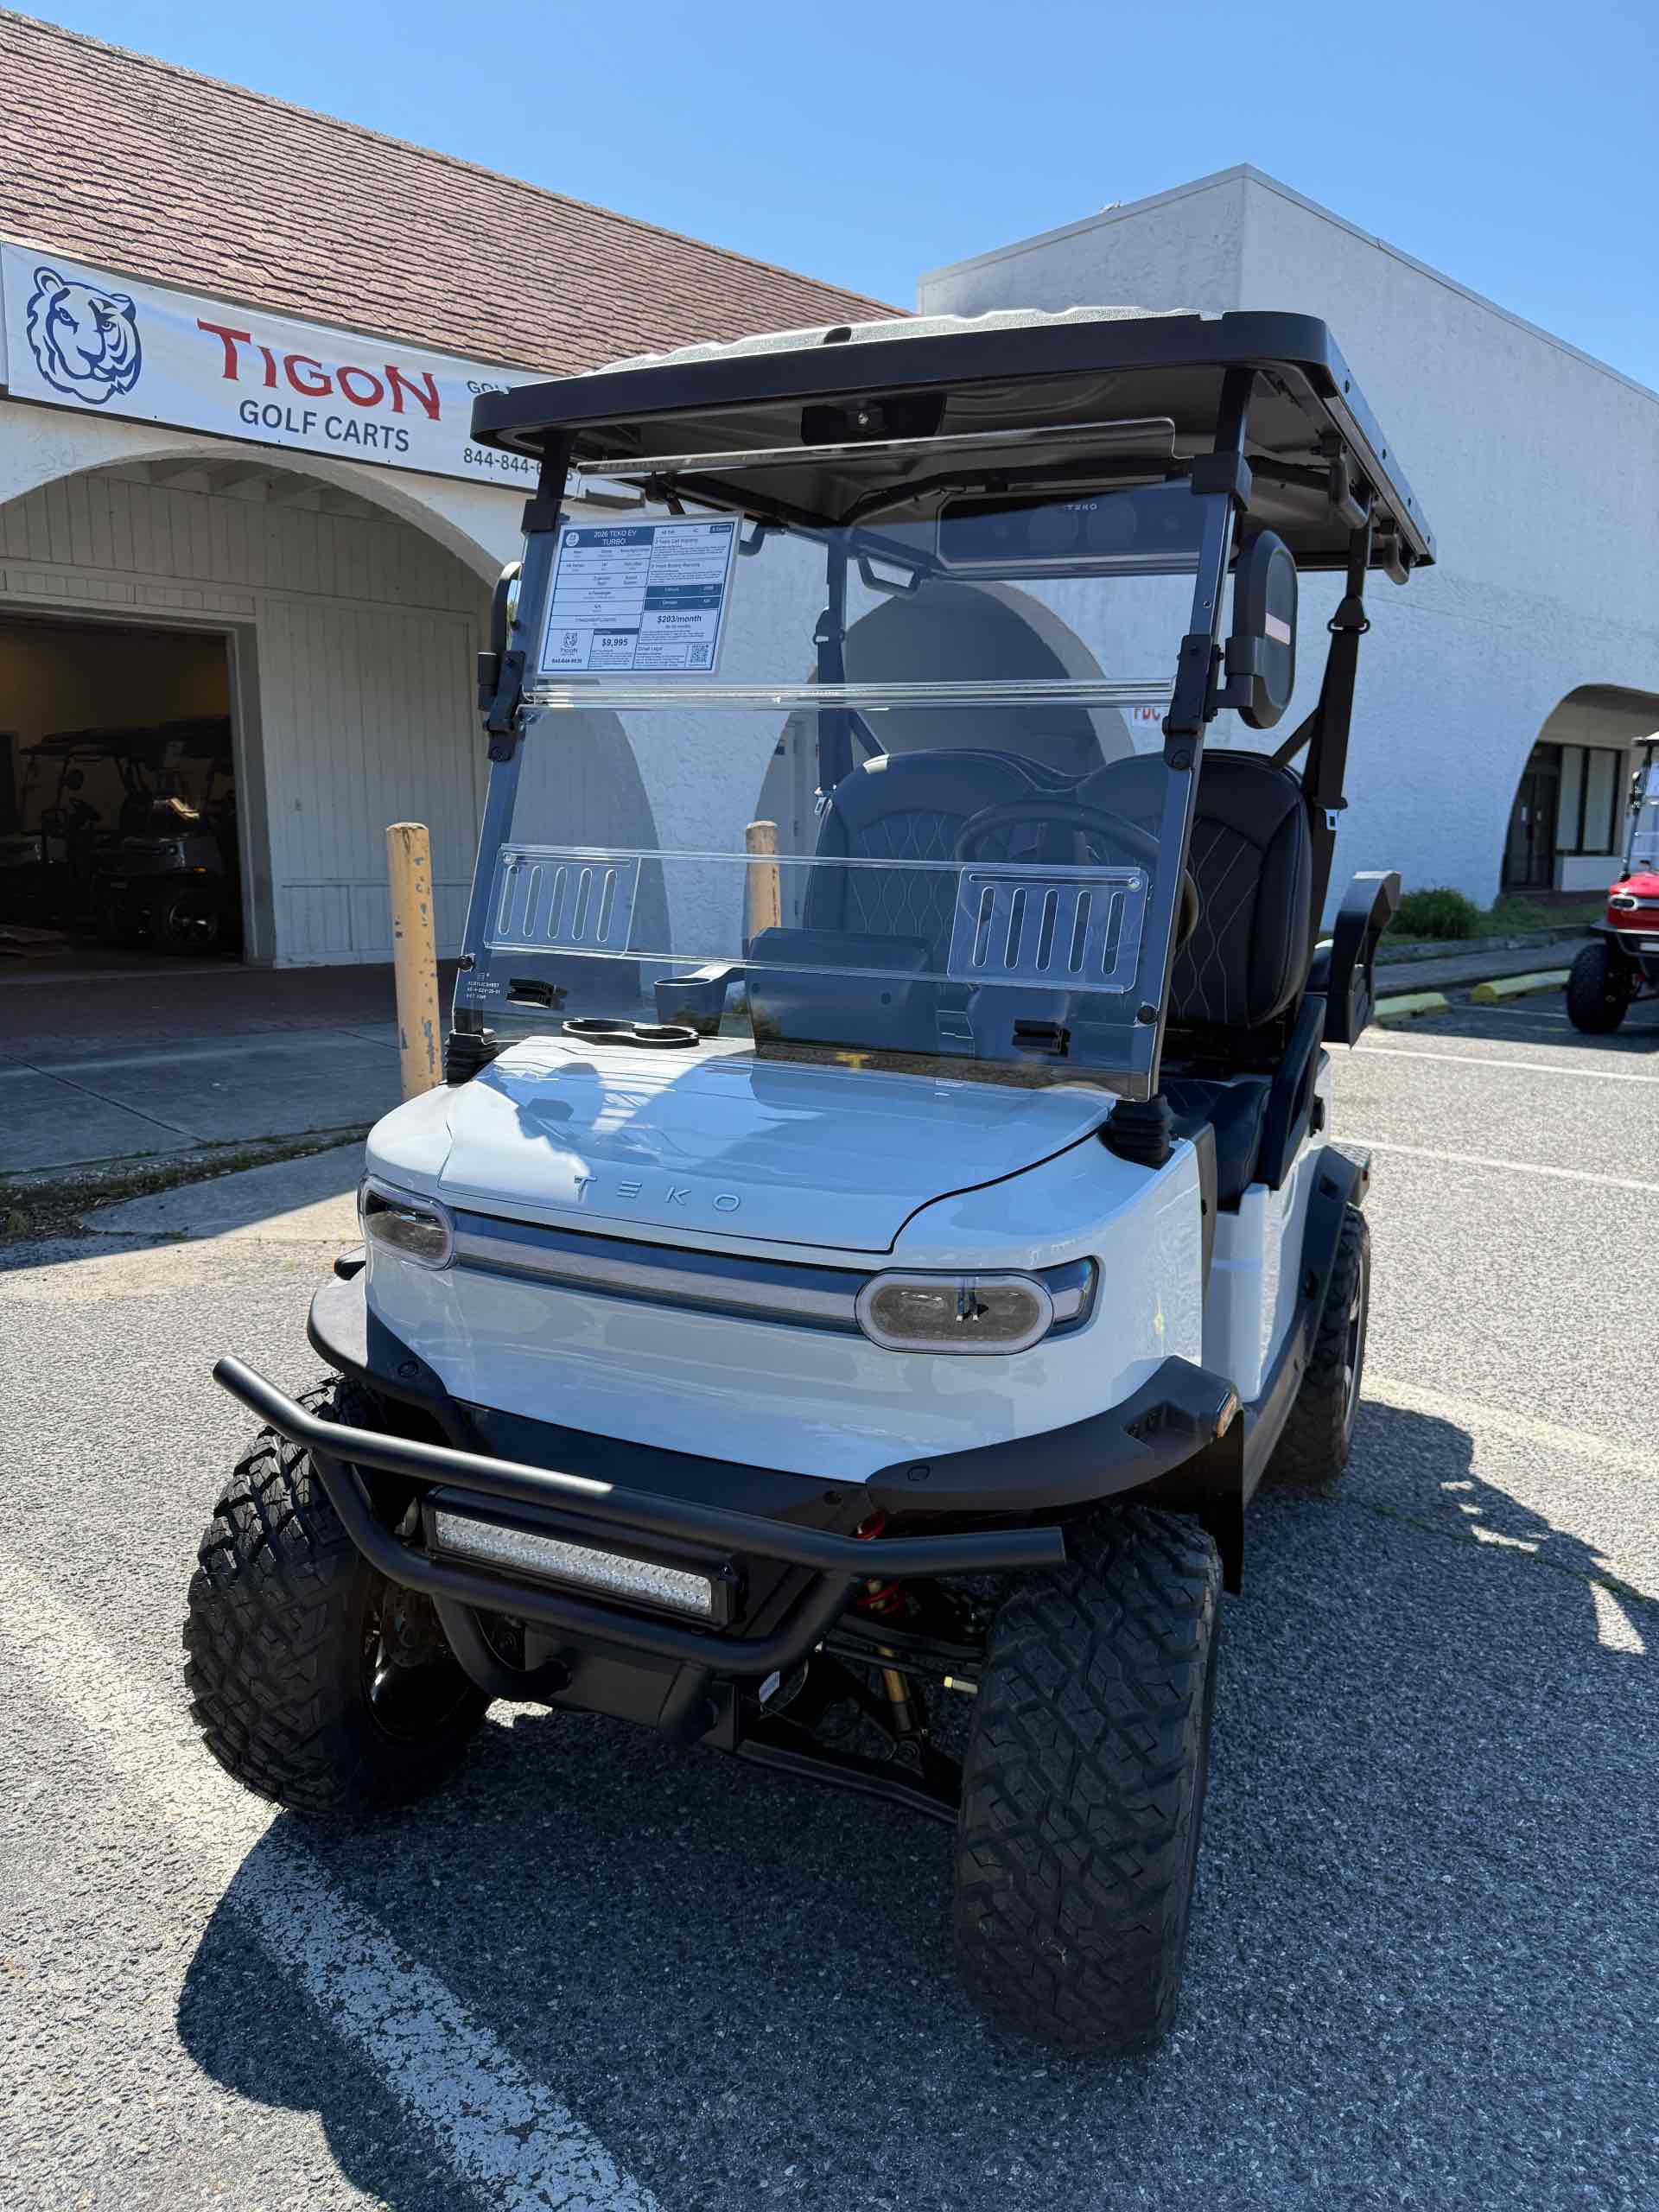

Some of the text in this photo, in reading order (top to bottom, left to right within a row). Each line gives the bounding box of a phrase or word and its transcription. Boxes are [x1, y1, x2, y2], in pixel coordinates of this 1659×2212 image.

[197, 317, 442, 421] TIGON
[238, 399, 410, 452] GOLF CARTS
[463, 448, 574, 481] 844-844-
[657, 614, 702, 623] $203/month
[601, 638, 628, 647] $9,995
[574, 1175, 741, 1211] TEKO
